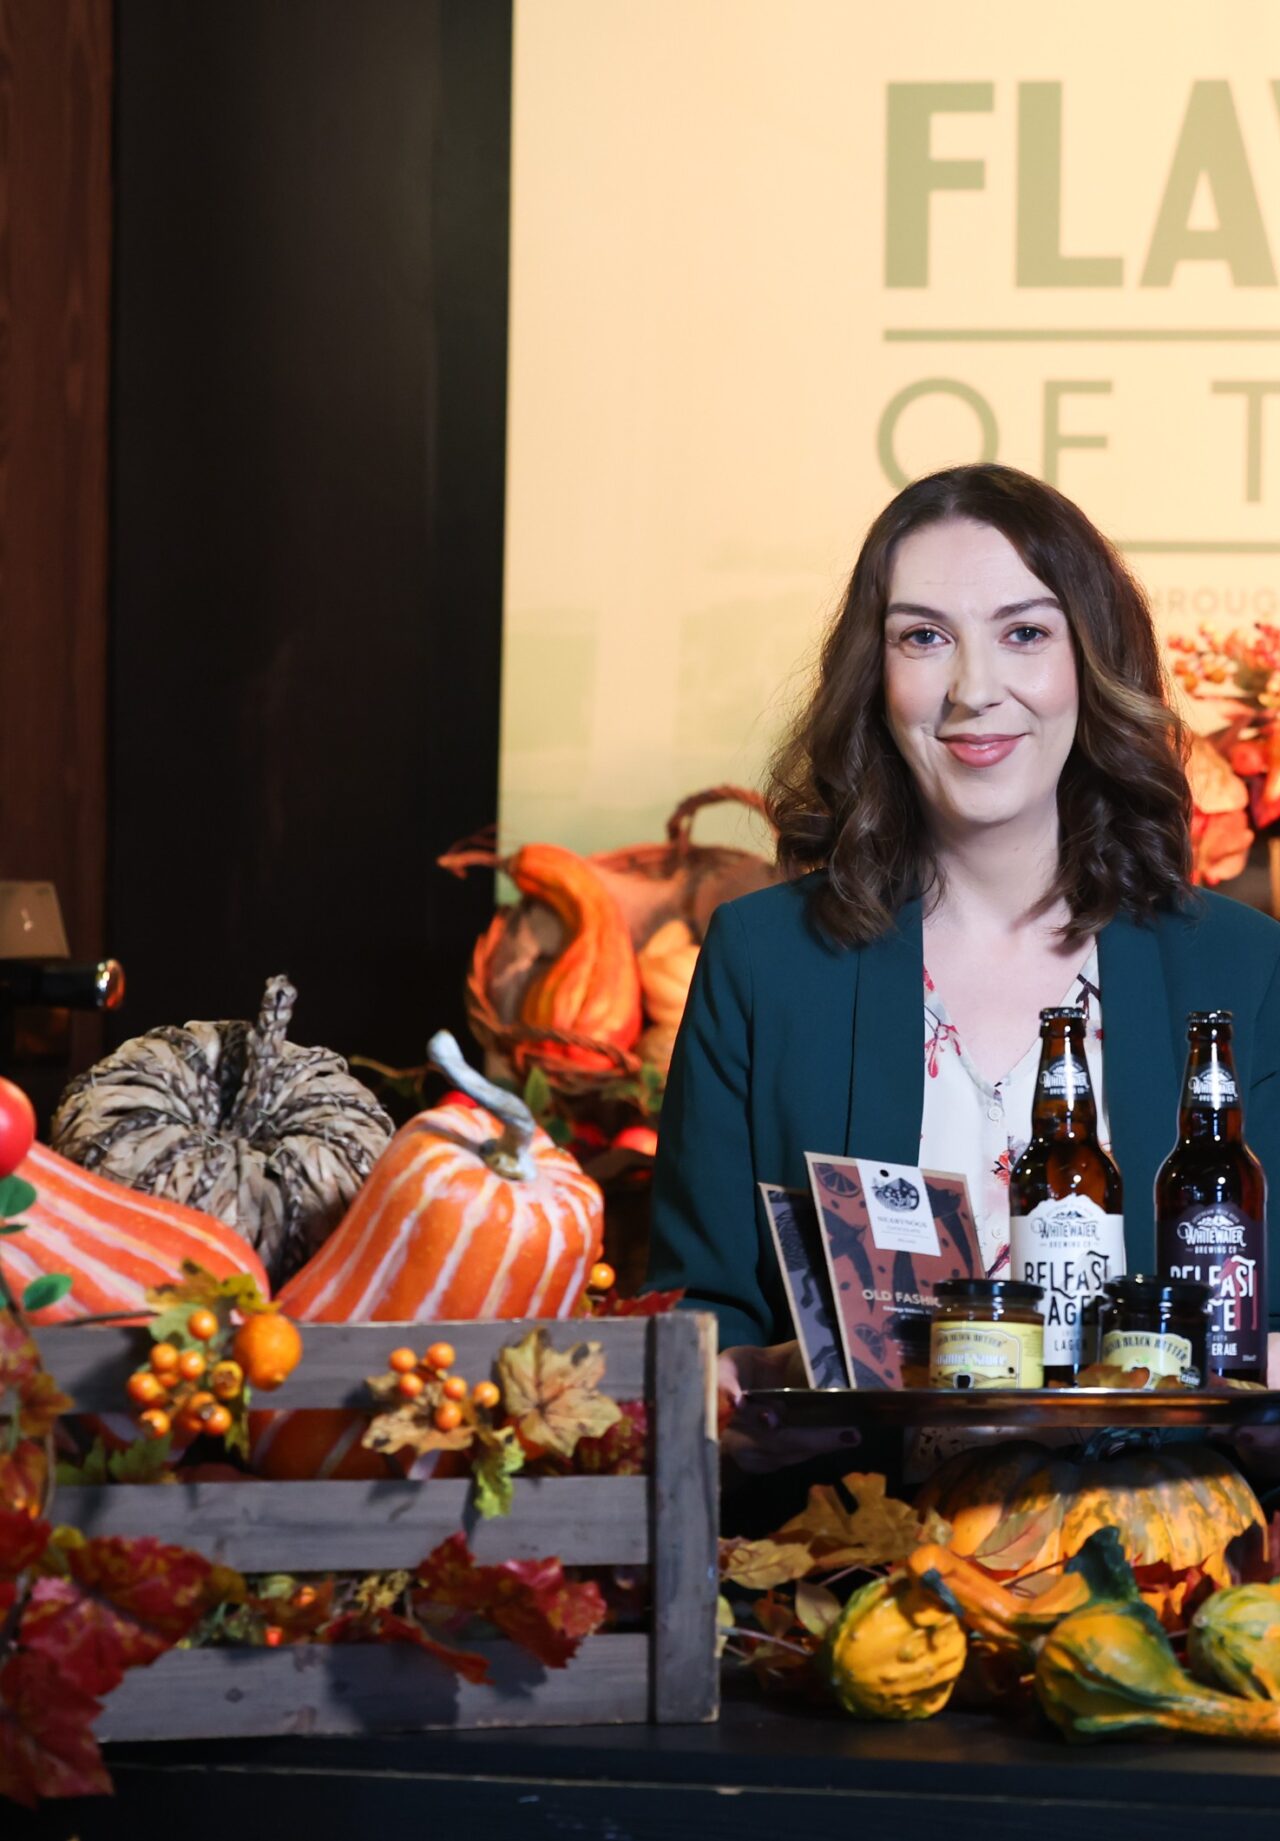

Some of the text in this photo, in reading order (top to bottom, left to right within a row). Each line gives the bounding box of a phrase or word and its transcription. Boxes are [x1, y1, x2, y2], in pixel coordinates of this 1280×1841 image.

[875, 376, 1114, 496] OF
[1177, 1222, 1247, 1248] WHITEWATER
[1195, 1246, 1227, 1254] BREWING
[862, 1289, 893, 1301] OLD
